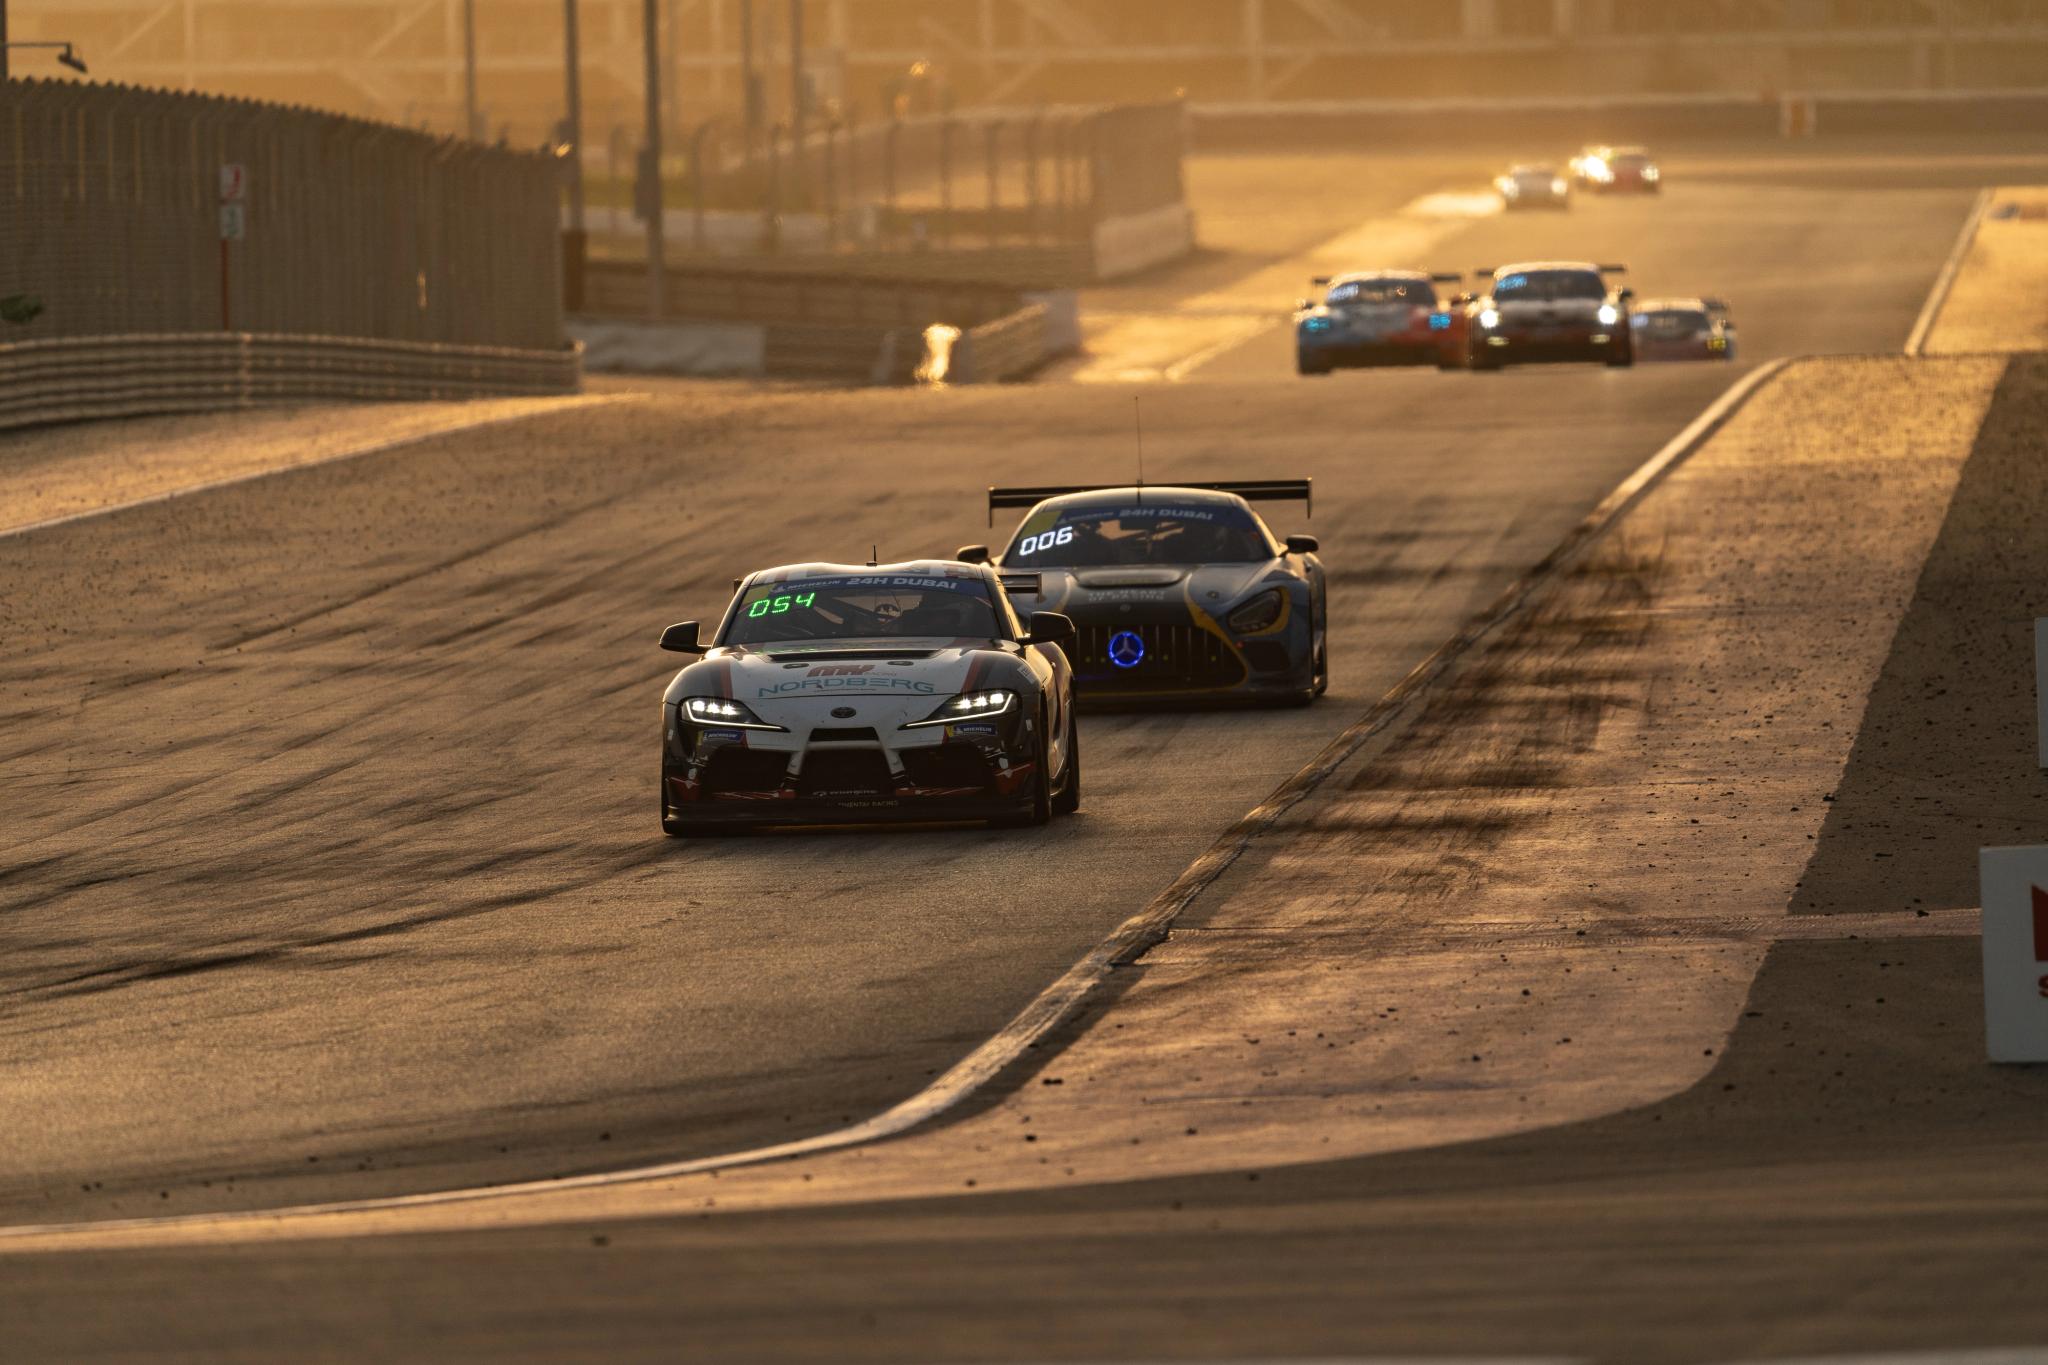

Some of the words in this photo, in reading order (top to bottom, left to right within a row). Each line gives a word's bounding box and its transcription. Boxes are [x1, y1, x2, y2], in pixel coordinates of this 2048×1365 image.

[1119, 508, 1155, 517] 24H
[1158, 508, 1214, 520] DUBAI
[1019, 526, 1073, 556] 006
[846, 577, 889, 586] 24H
[892, 577, 958, 589] DUBAI
[749, 592, 816, 618] 054
[758, 677, 935, 697] NORDBERG
